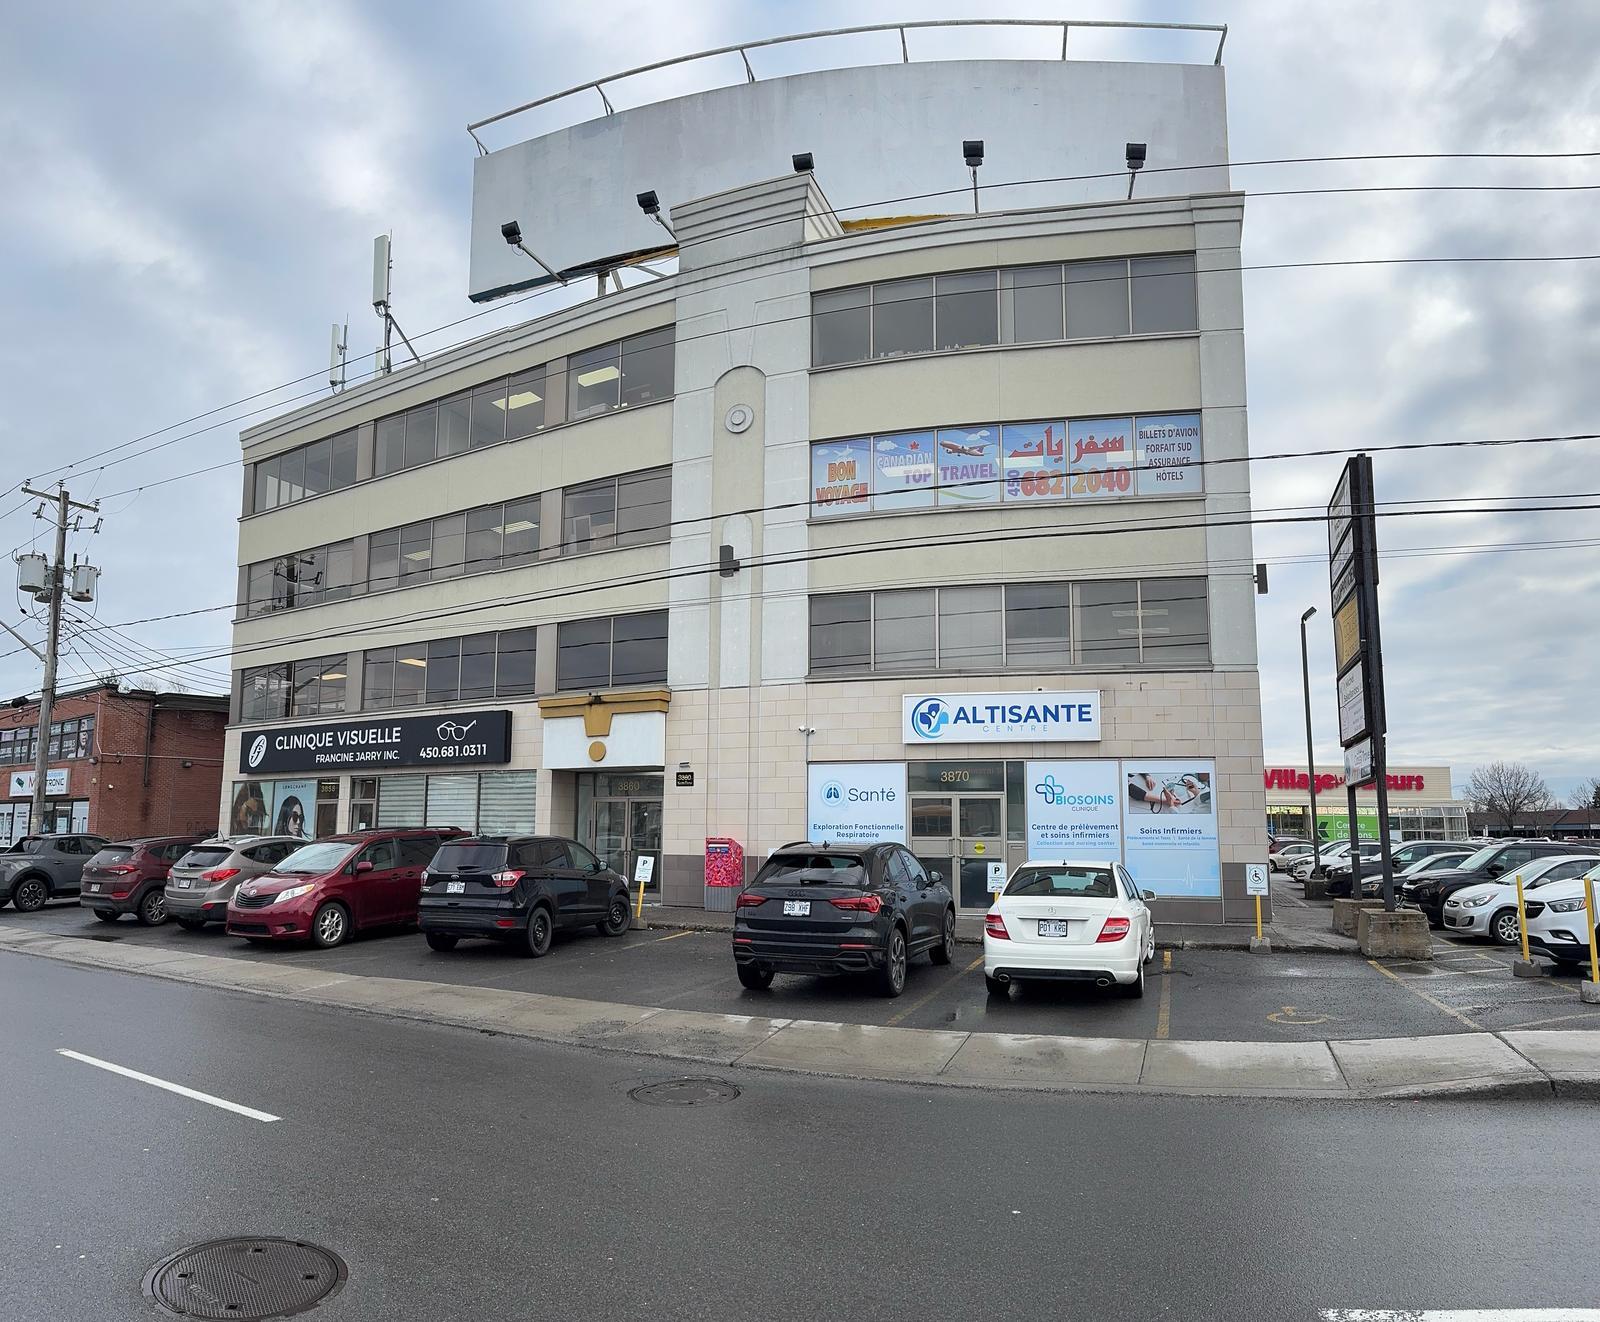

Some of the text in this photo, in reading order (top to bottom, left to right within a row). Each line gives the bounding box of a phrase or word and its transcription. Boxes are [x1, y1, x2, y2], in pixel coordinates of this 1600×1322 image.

[1139, 427, 1198, 439] BILLETS D'AVION
[1145, 442, 1192, 453] FORFAIT SUD
[876, 452, 932, 469] CANADIAN
[1148, 456, 1191, 467] ASSURANCE
[827, 460, 857, 482] BON
[903, 463, 998, 484] TOP TRAVEL
[1156, 470, 1184, 481] HÔTELS
[1007, 465, 1131, 497] 450 682 2040
[816, 483, 868, 507] VOYAGE
[953, 704, 1092, 725] ALTISANTE
[982, 725, 1049, 733] CENTRE
[275, 727, 401, 750] CLINIQUE VISUELLE
[315, 750, 400, 763] FRANCINE JARRY INC.
[419, 744, 487, 758] 450.681.0311
[940, 771, 970, 782] 3870
[1265, 769, 1336, 794] Village
[848, 787, 896, 802] Santé
[1055, 795, 1114, 805] BIOSOINS
[1031, 823, 1119, 832] Centre de prélèvement
[1139, 827, 1203, 835] Soins Infirmiers
[836, 831, 880, 839] Respiratoire
[642, 859, 648, 867] P
[994, 866, 1000, 874] P
[1053, 923, 1065, 932] KRG
